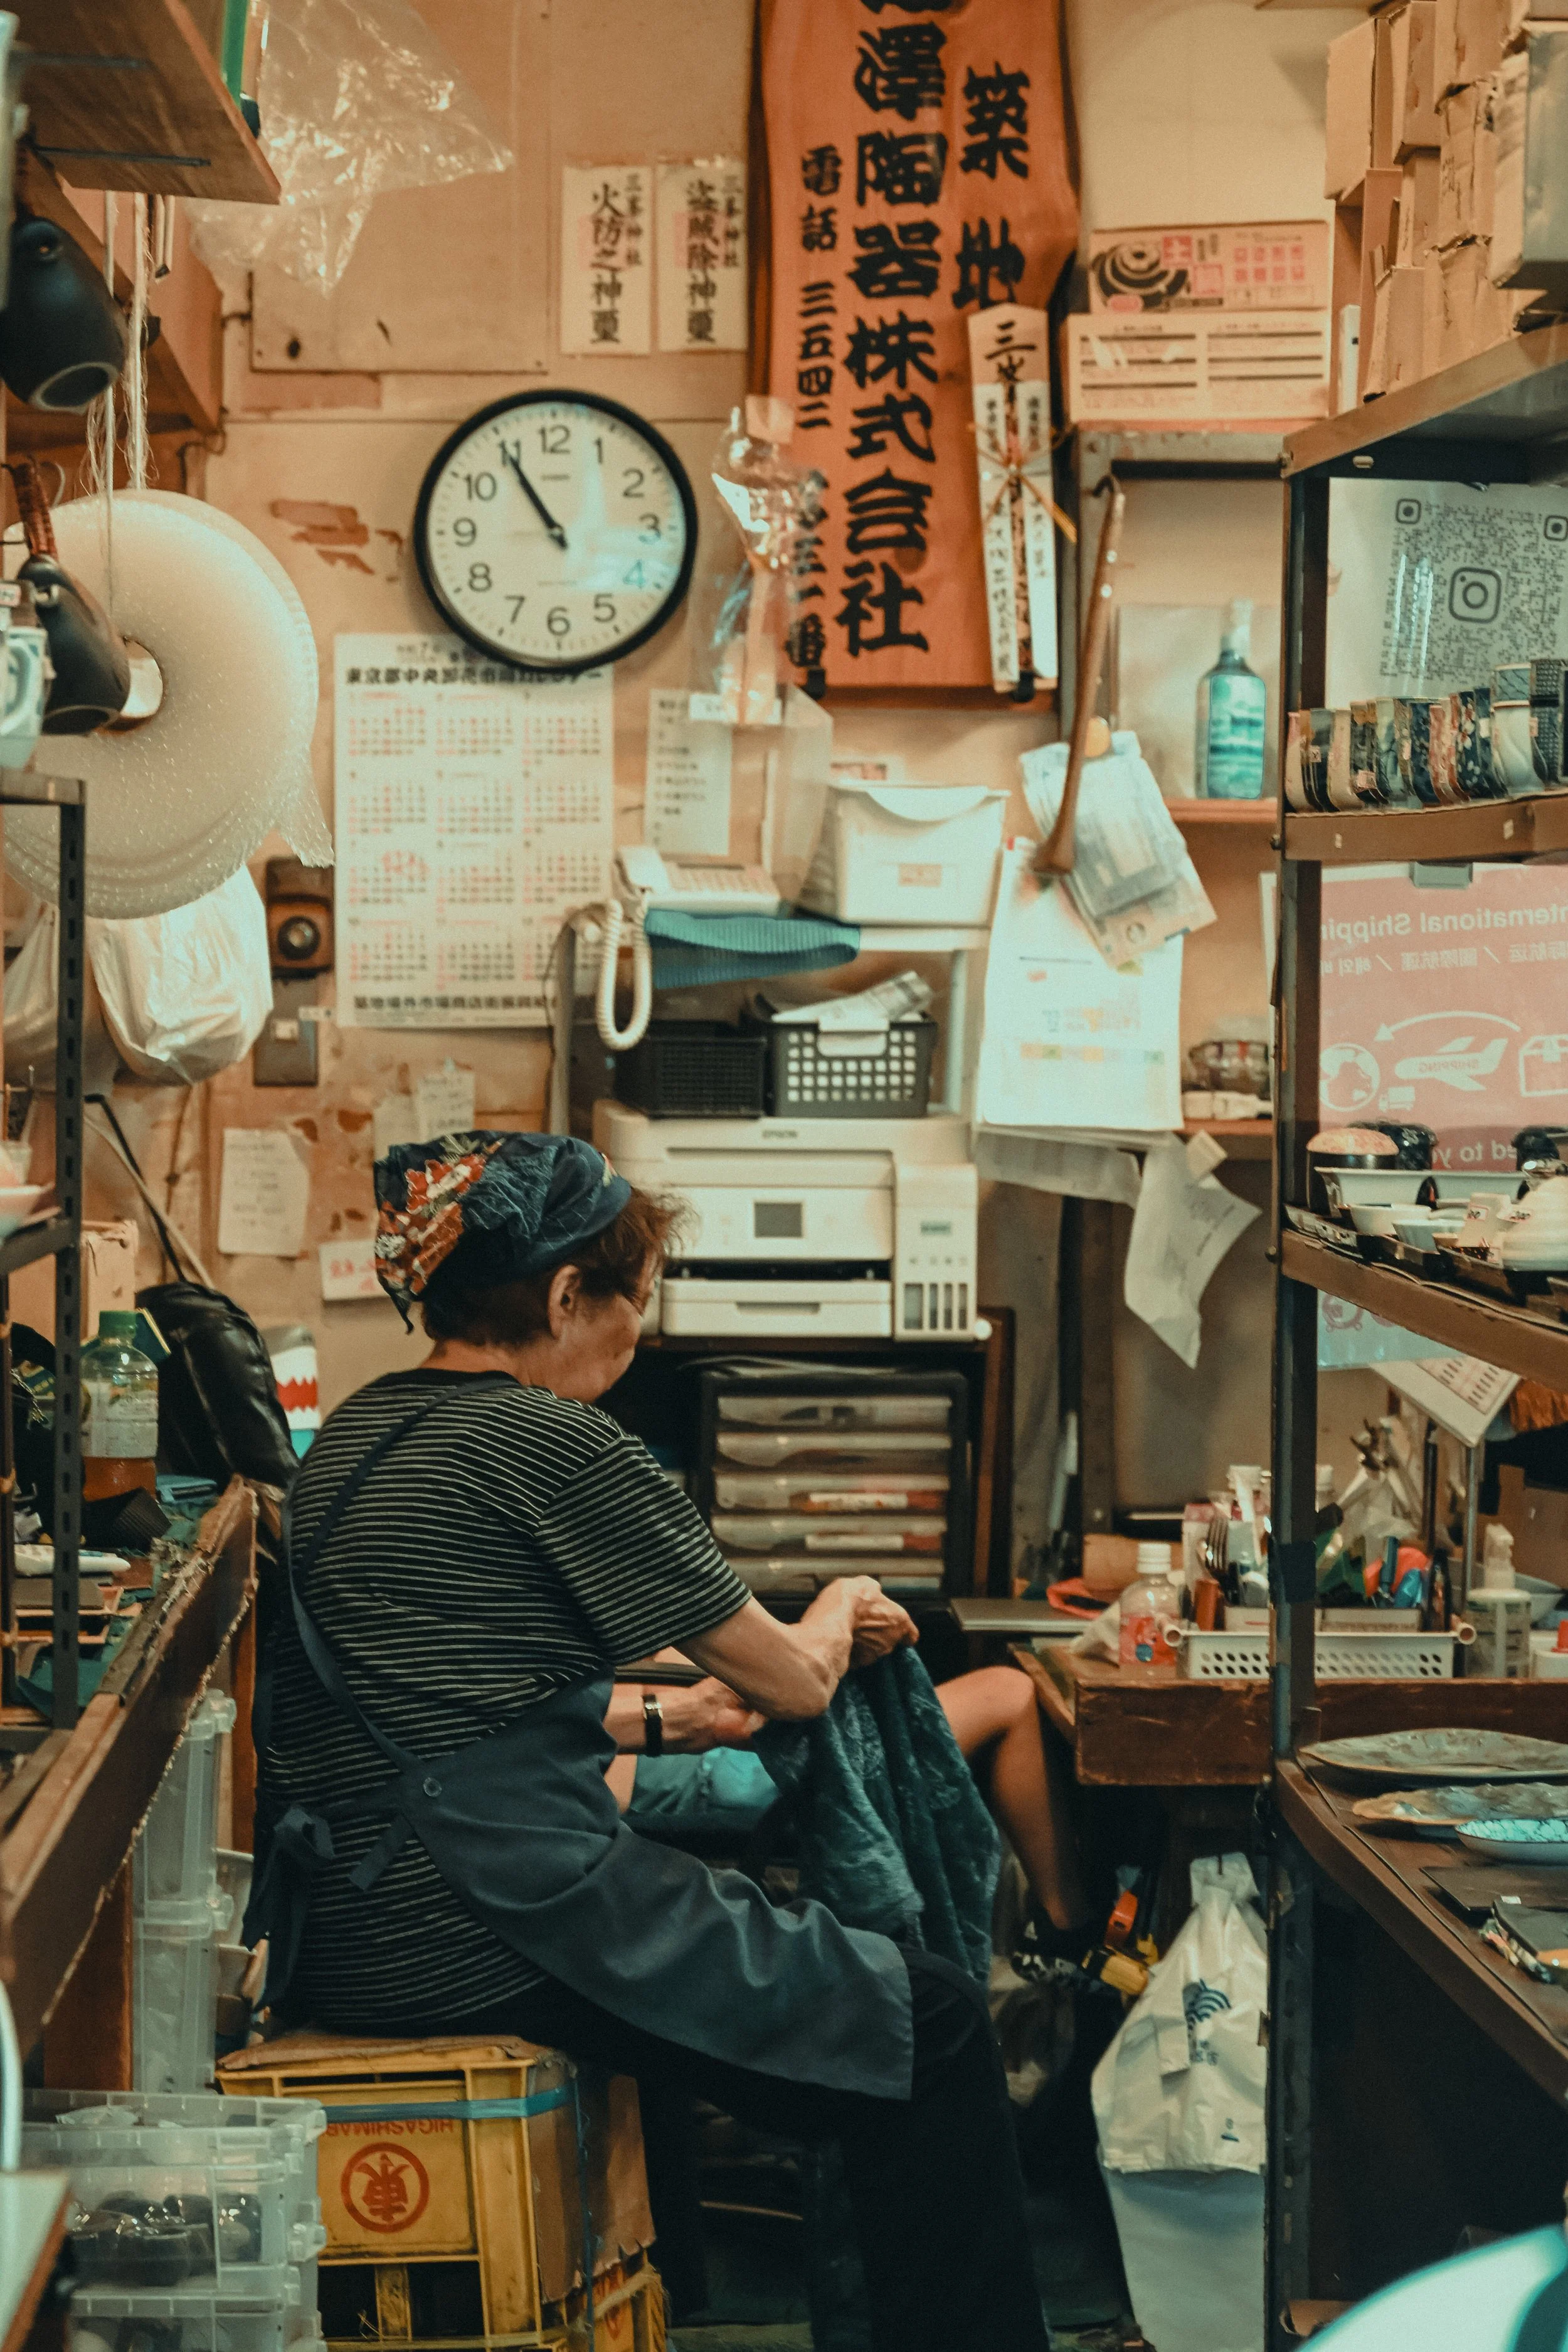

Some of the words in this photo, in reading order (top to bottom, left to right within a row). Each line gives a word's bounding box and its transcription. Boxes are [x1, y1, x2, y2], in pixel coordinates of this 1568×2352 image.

[837, 0, 949, 657] 澤陶器株式会社
[499, 438, 522, 467] 11
[538, 425, 571, 455] 12
[593, 438, 604, 464] 1
[465, 472, 497, 502] 10
[622, 468, 645, 499] 2
[452, 517, 477, 548] 9
[638, 512, 662, 544] 3
[468, 563, 492, 593] 8
[623, 559, 645, 588] 4
[504, 595, 526, 624] 7
[546, 606, 571, 637] 6
[593, 593, 617, 623] 5
